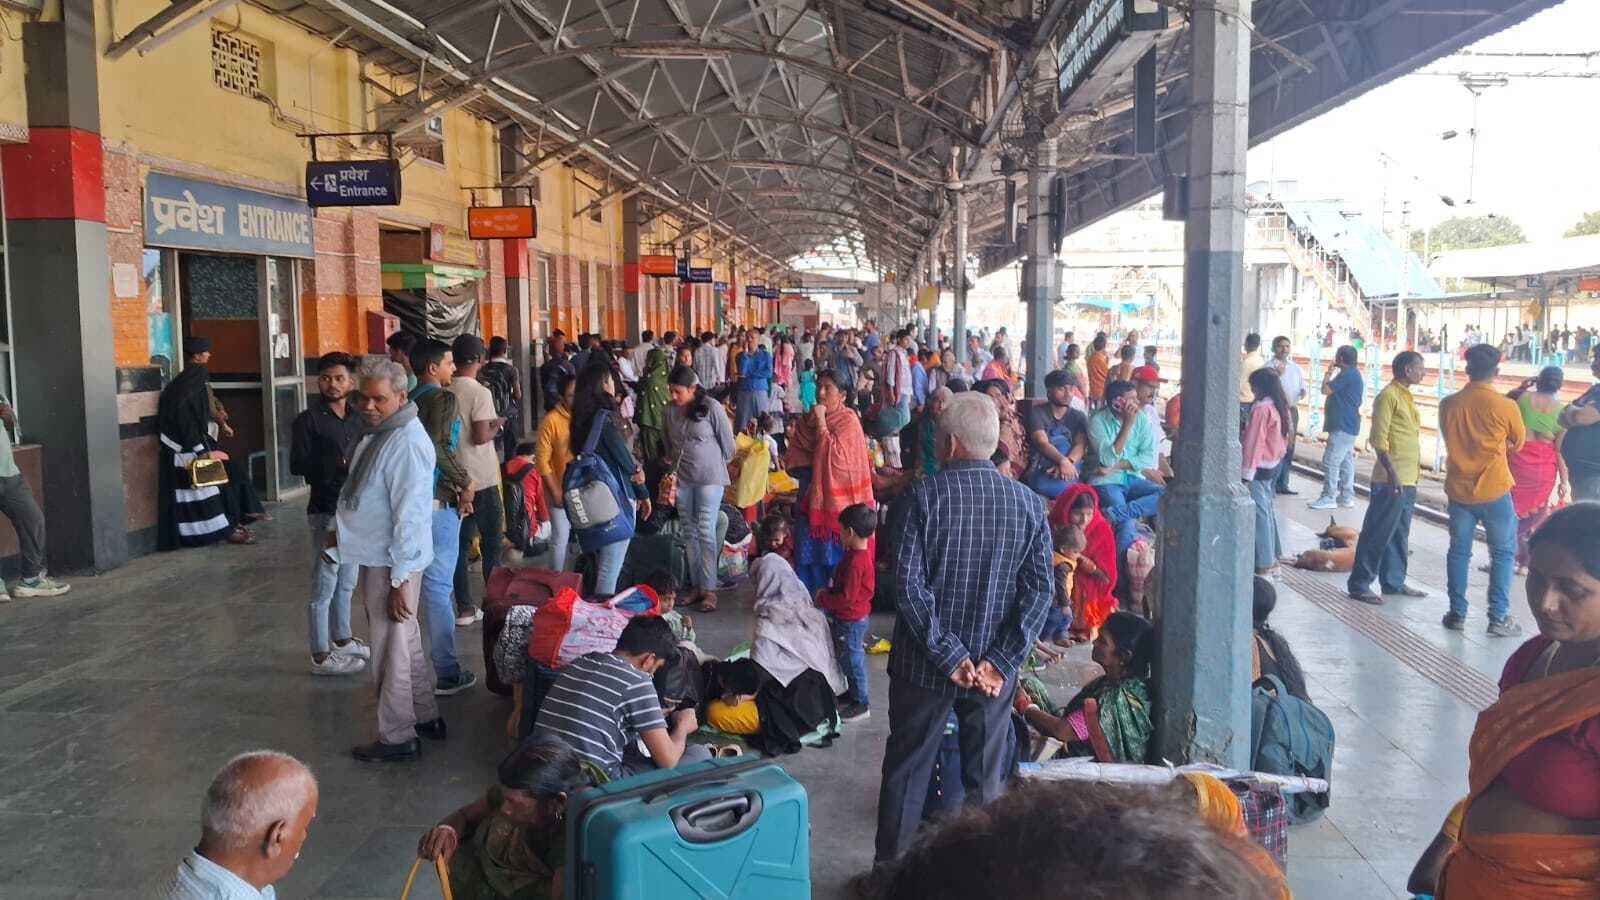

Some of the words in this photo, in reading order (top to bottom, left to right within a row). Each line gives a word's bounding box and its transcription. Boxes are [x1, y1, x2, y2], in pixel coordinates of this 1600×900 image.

[339, 166, 369, 182] प्रवेश
[340, 185, 388, 197] Entrance
[150, 189, 226, 236] प्रवेश
[238, 203, 310, 245] ENTRANCE
